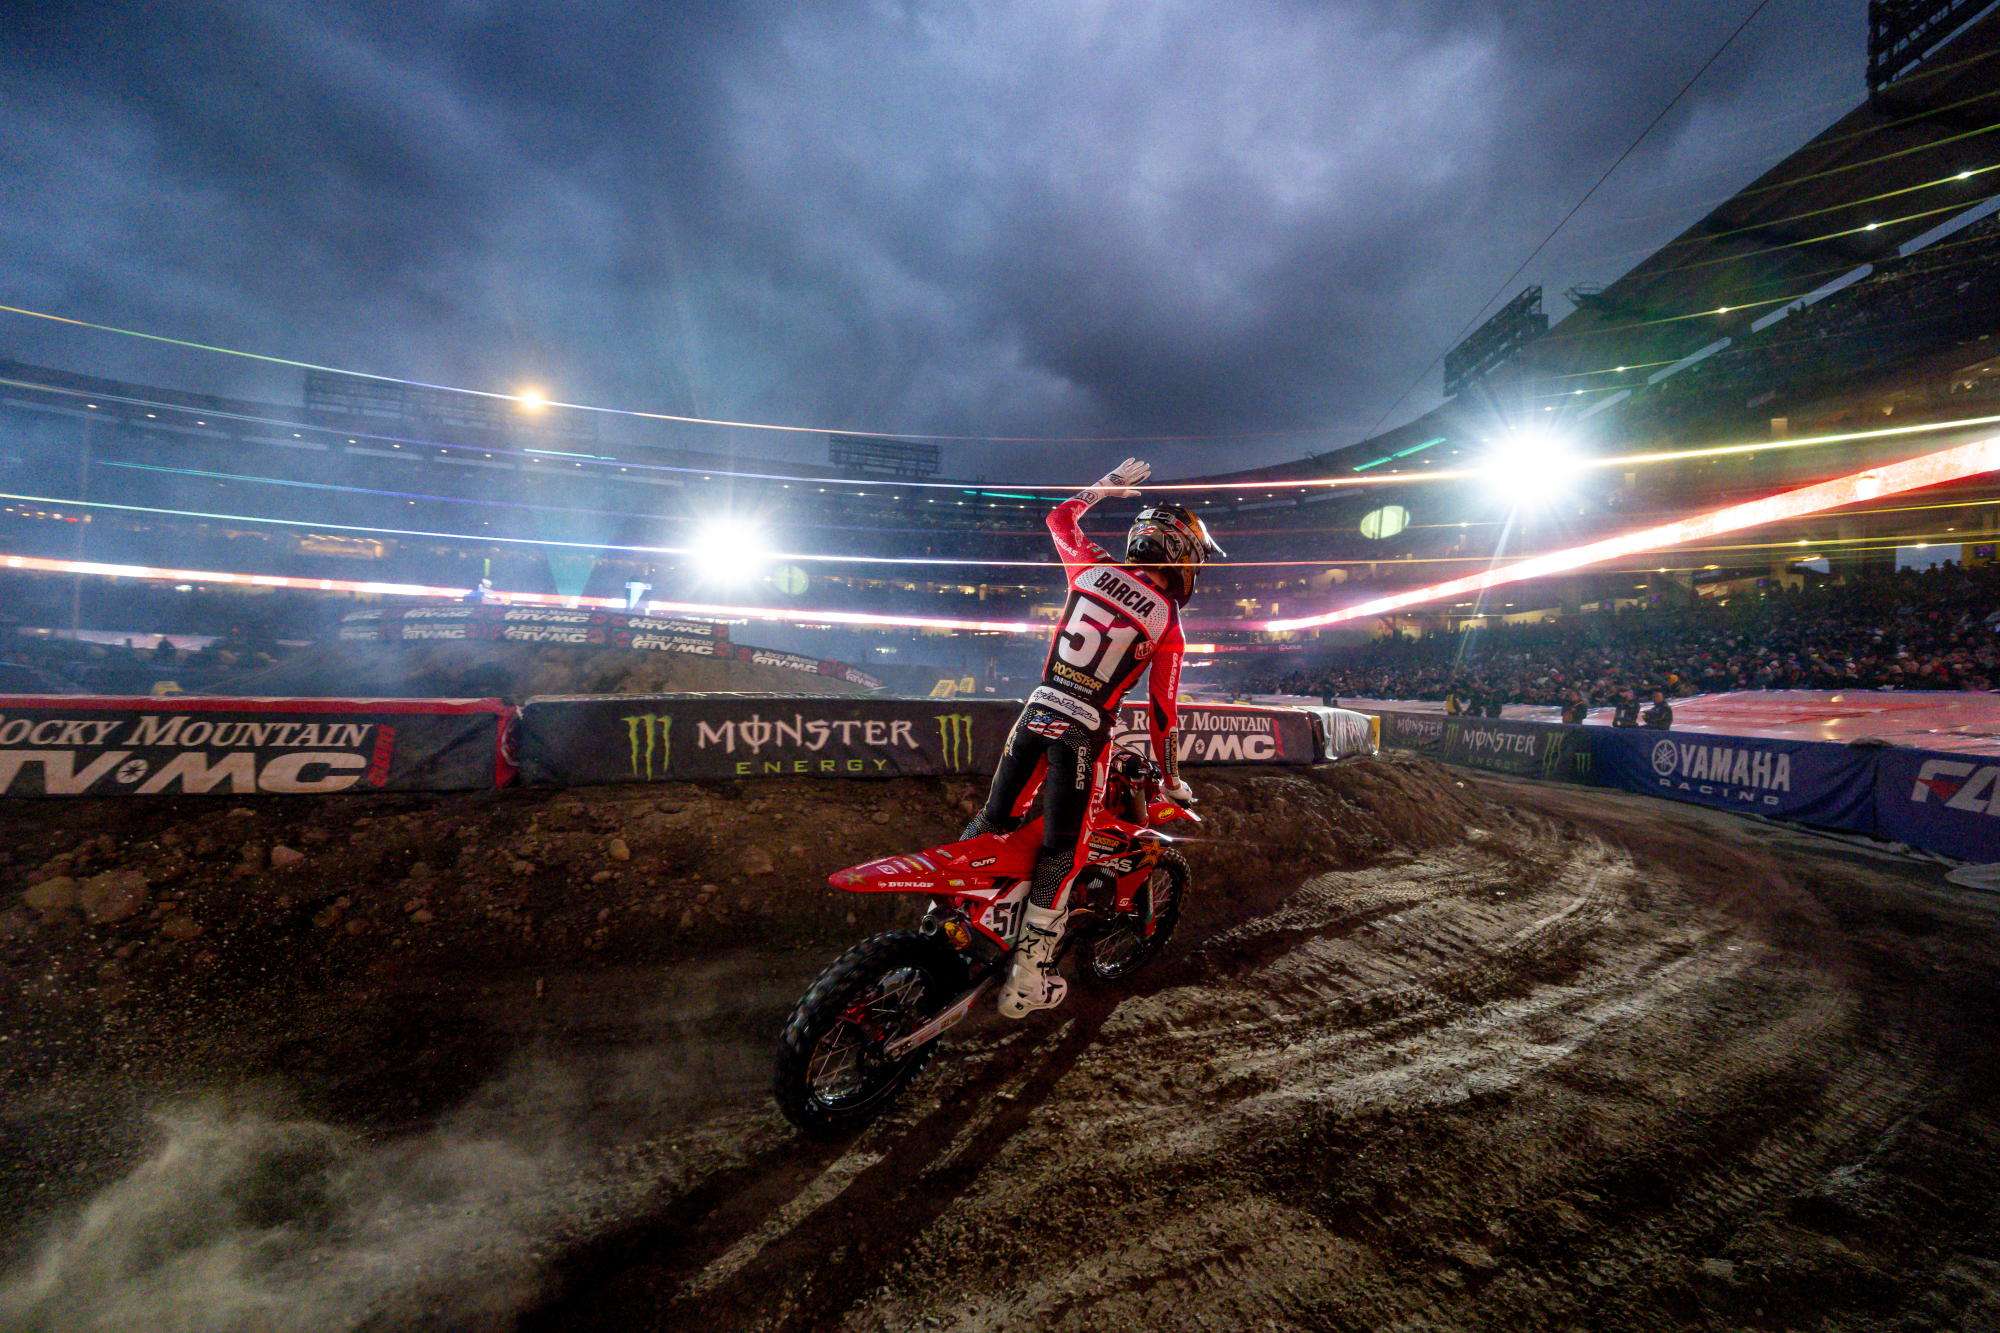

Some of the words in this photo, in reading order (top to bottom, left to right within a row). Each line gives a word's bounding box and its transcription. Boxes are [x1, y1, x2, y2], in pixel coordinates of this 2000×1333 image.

[1052, 532, 1078, 557] GASGAS
[1093, 572, 1156, 618] BARCIA
[1059, 595, 1139, 684] 51
[1052, 661, 1103, 691] ROCKSTAR
[1074, 684, 1094, 696] DRINK
[1168, 652, 1178, 699] GASGAS
[0, 714, 124, 746] OCKY
[121, 716, 373, 748] MOUNTAIN
[1193, 712, 1271, 732] MOUNTAIN
[736, 758, 889, 775] ENERGY
[1680, 744, 1790, 792] YAMAHA
[1660, 779, 1780, 806] RACING
[971, 856, 997, 868] GUTS
[993, 901, 1020, 938] 51
